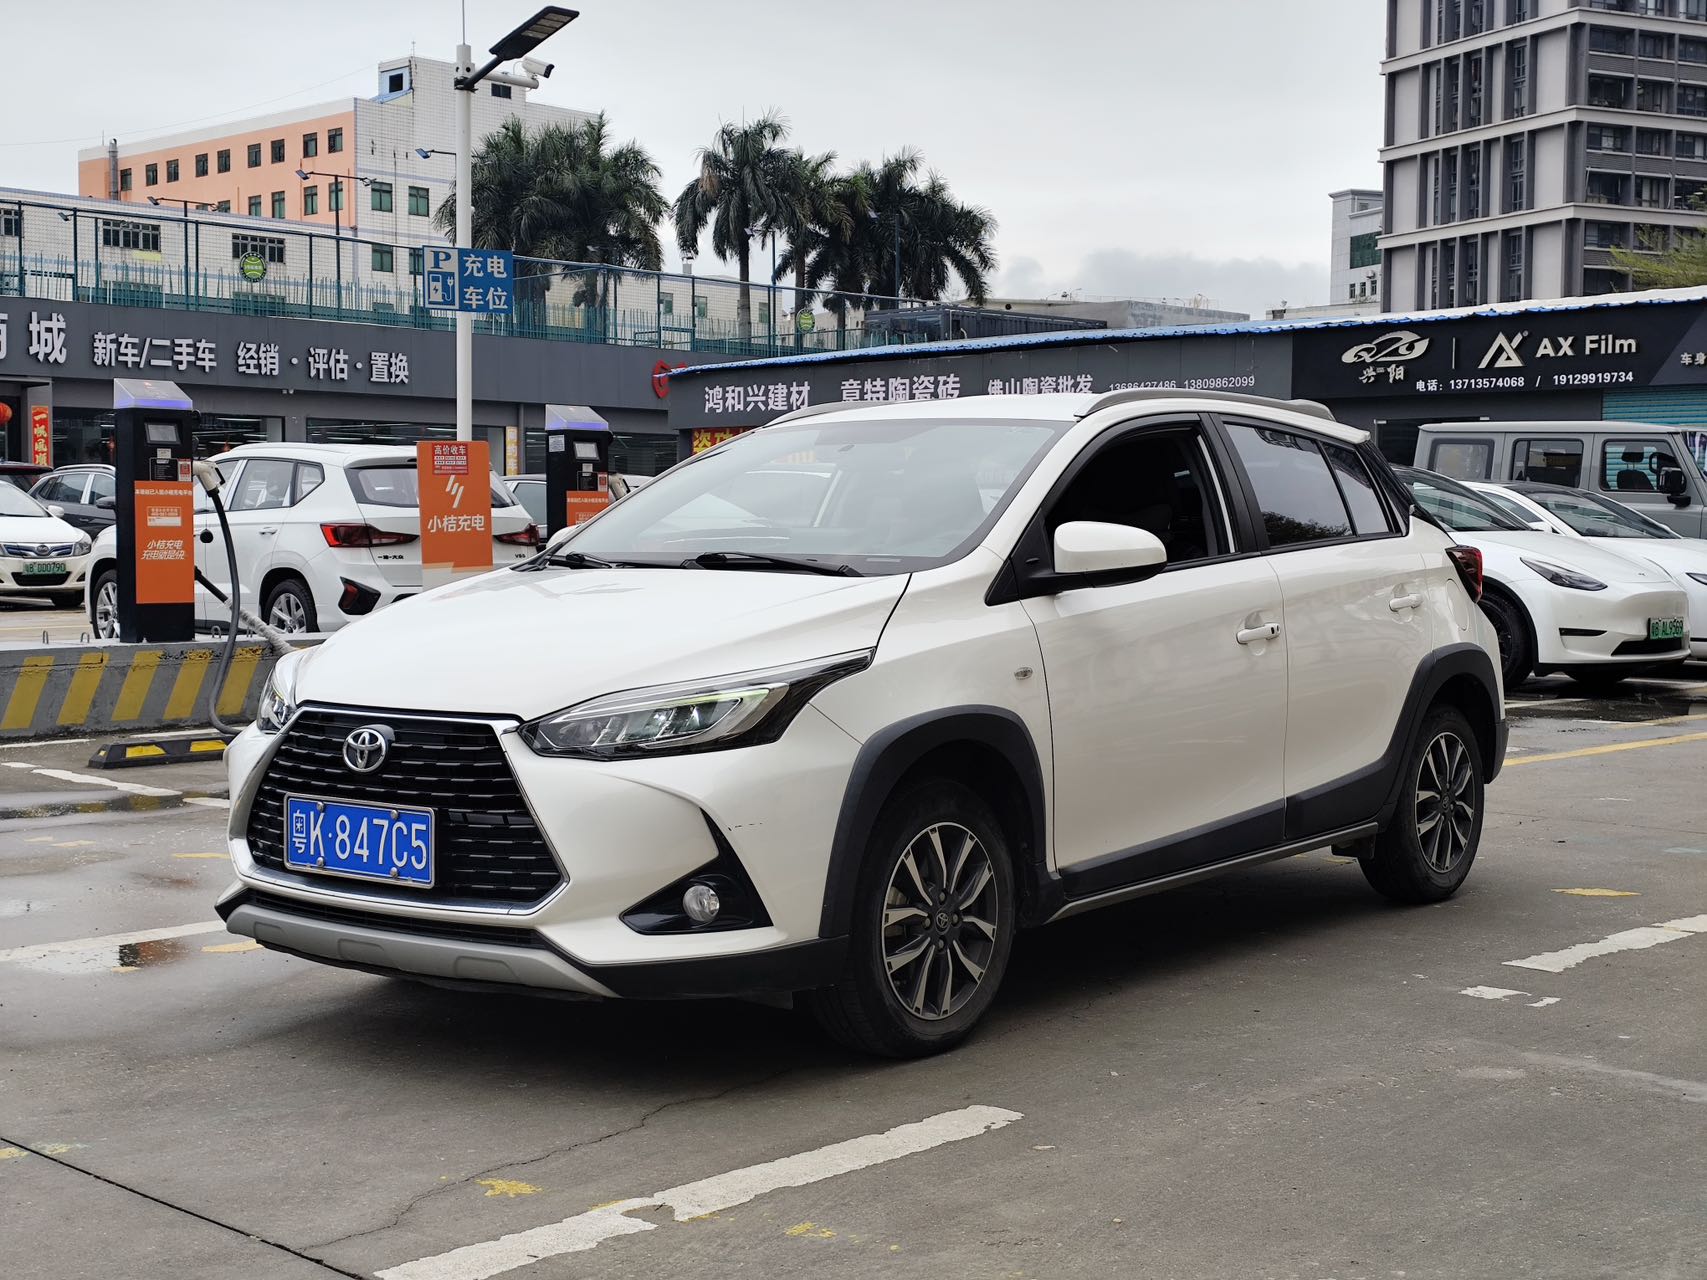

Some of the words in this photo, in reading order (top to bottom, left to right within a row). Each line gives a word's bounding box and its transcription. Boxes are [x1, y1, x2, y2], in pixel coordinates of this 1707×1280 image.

[430, 250, 452, 269] P
[463, 254, 508, 278] 充电
[463, 286, 508, 310] 车位
[0, 312, 67, 364] 城
[1535, 335, 1576, 358] AX
[1585, 334, 1637, 355] Film
[93, 332, 218, 373] 新车/二手车
[1553, 371, 1634, 386] 19129919734
[705, 381, 810, 413] 鸿和兴建材
[841, 374, 961, 401] 意特陶瓷砖
[987, 374, 1094, 395] 佛山陶瓷批发
[1183, 375, 1255, 390] 13809862099
[427, 514, 486, 533] 小桔充电
[147, 539, 183, 549] 小桔充电
[292, 809, 427, 870] 粤K·847C5
